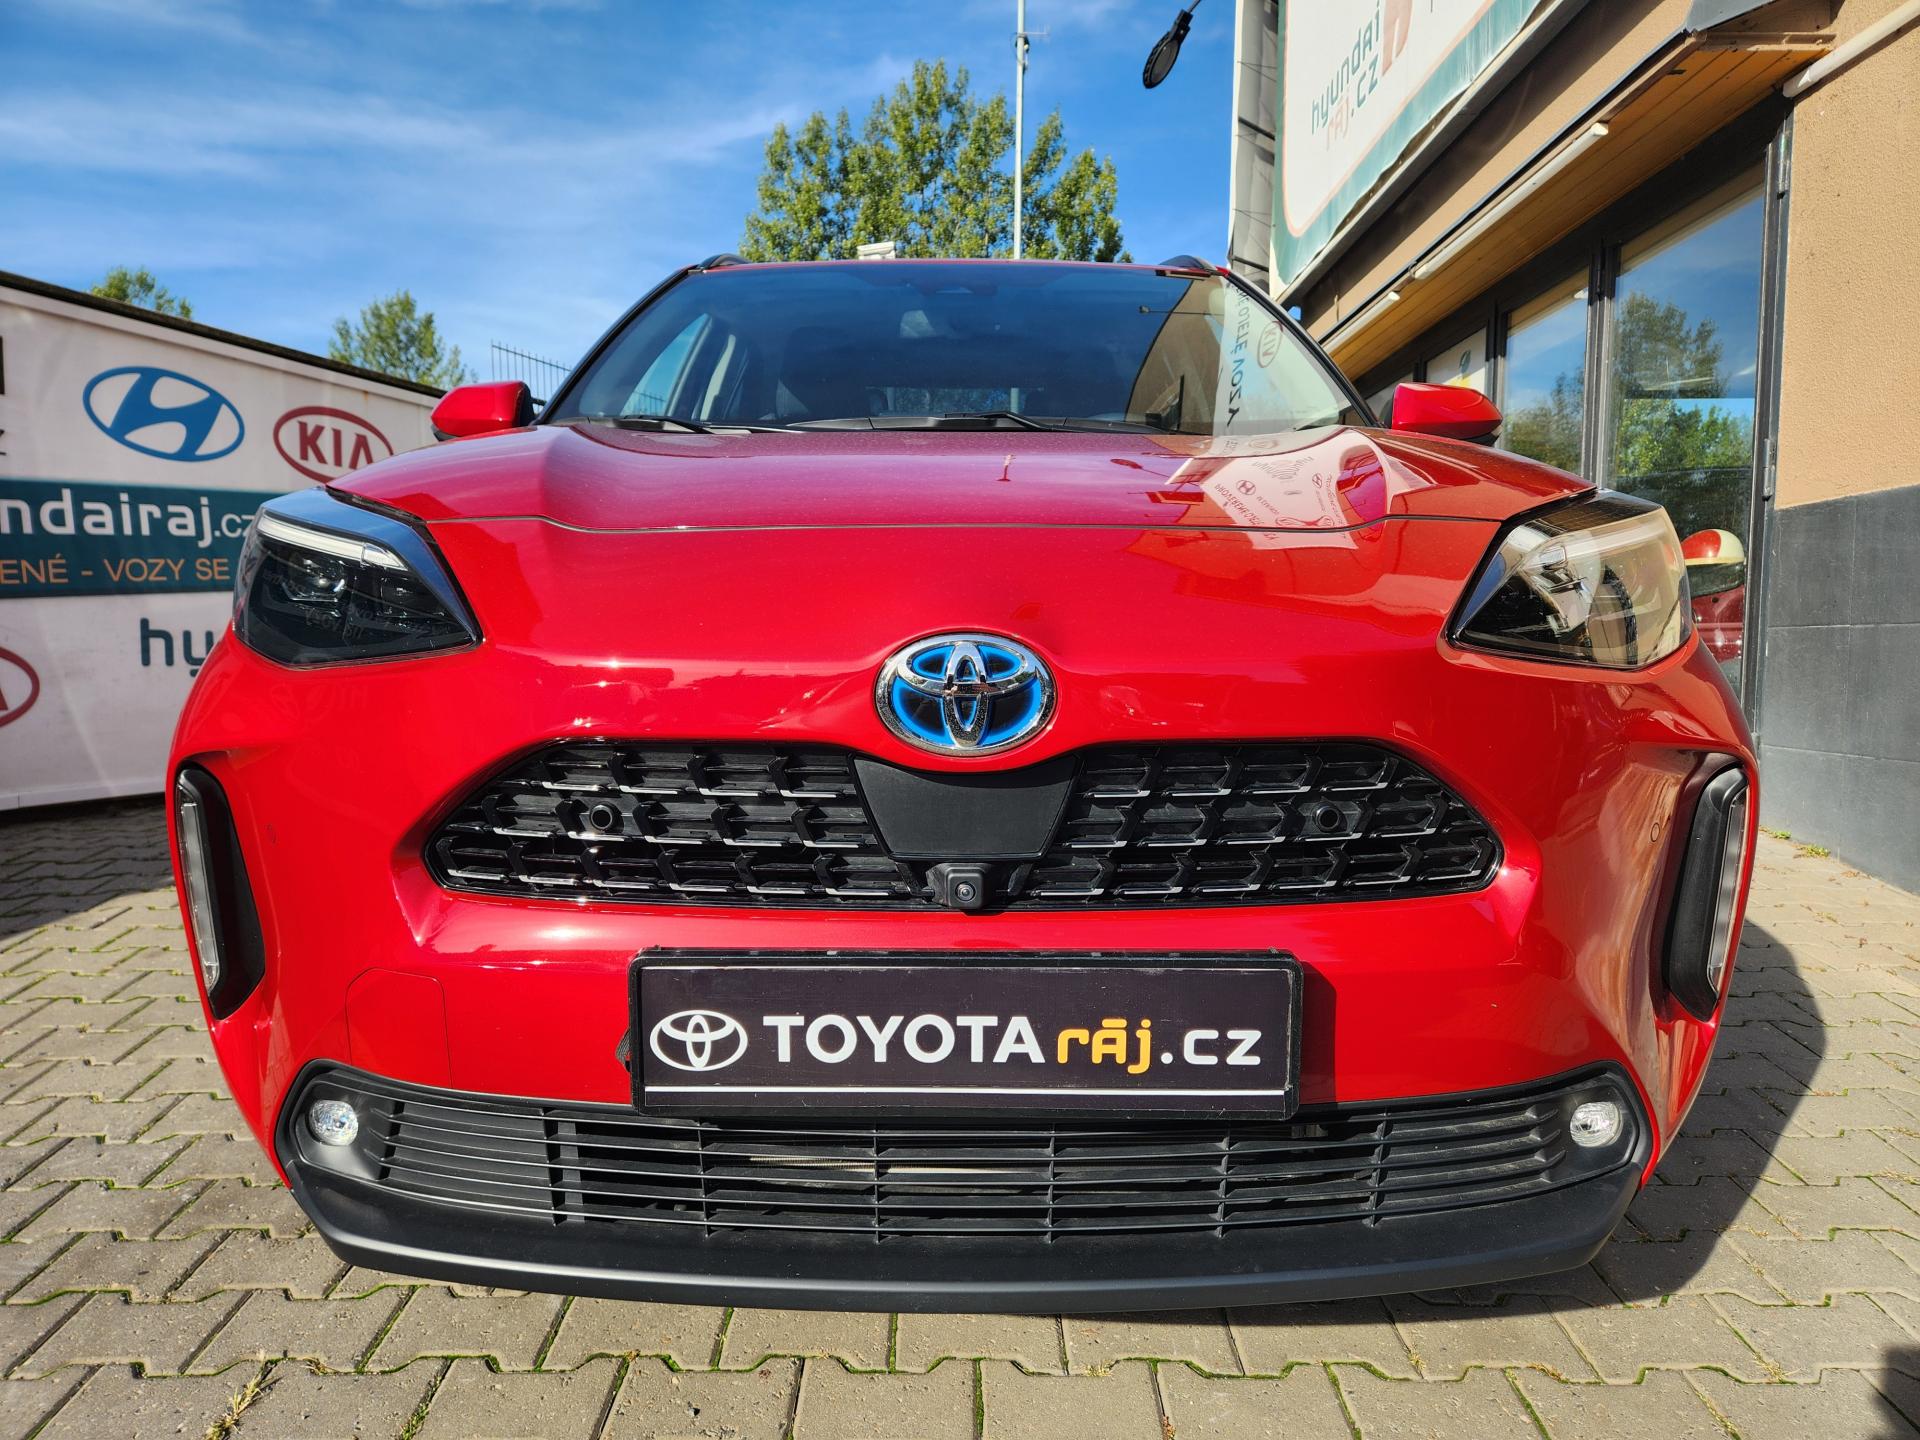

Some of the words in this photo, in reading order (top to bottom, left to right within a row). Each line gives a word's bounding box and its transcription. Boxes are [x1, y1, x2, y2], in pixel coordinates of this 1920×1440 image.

[297, 420, 374, 470] KIA
[103, 558, 185, 582] VOZY
[195, 558, 230, 580] SE
[763, 1014, 1046, 1063] TOYOTA
